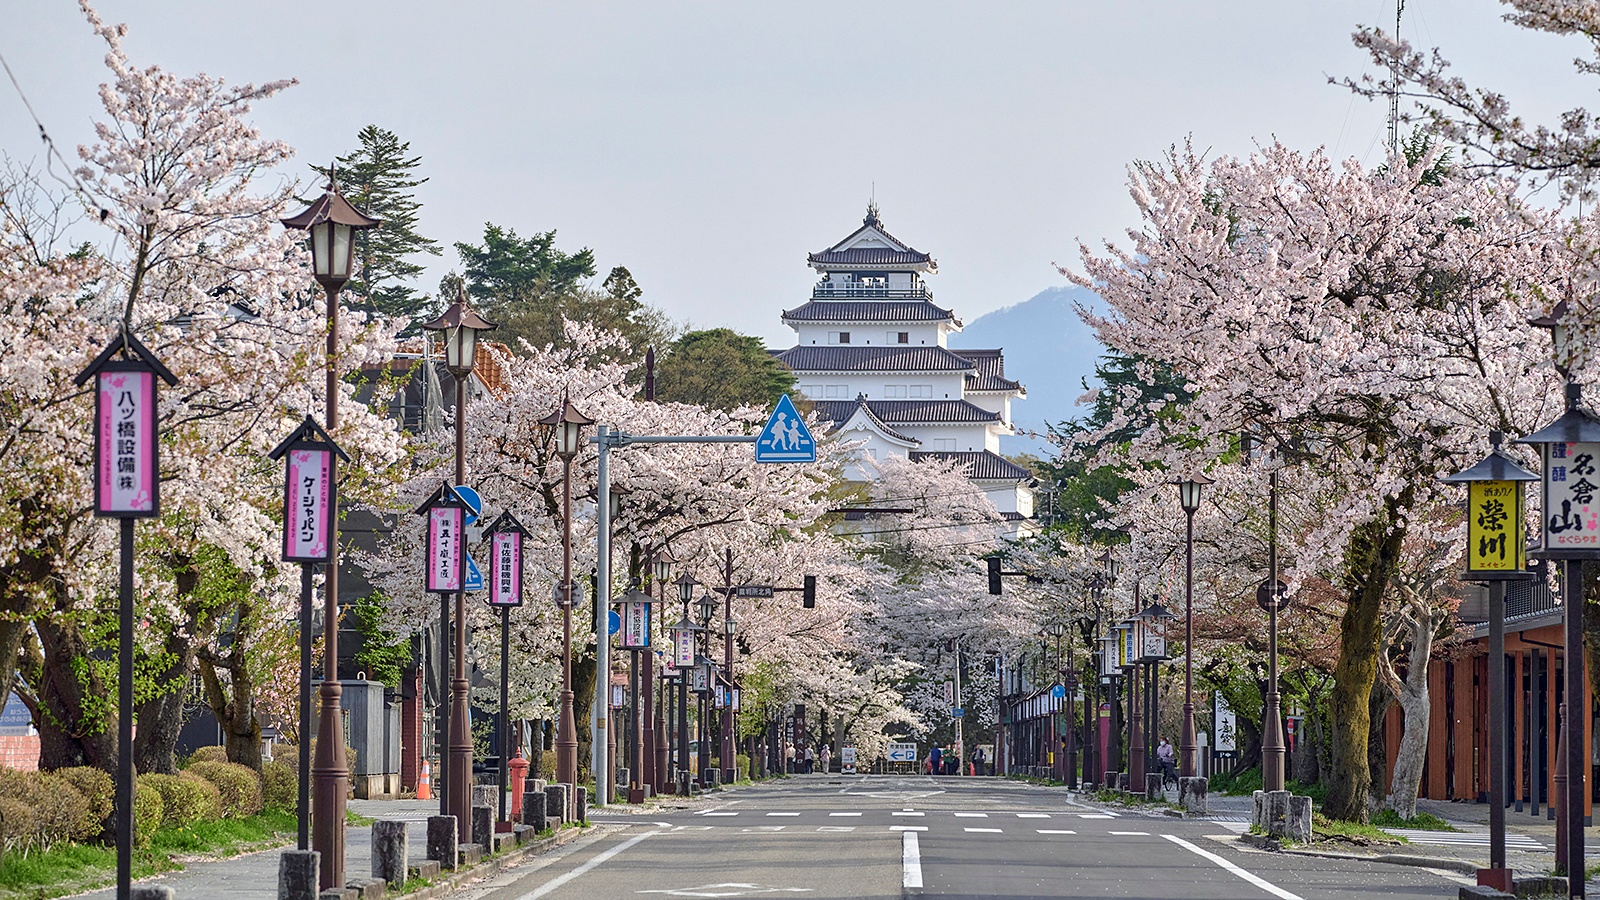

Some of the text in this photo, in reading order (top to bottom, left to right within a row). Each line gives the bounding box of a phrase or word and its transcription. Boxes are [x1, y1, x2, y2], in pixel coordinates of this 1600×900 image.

[301, 476, 315, 542] ケージャパン
[1549, 453, 1599, 535] 名倉山
